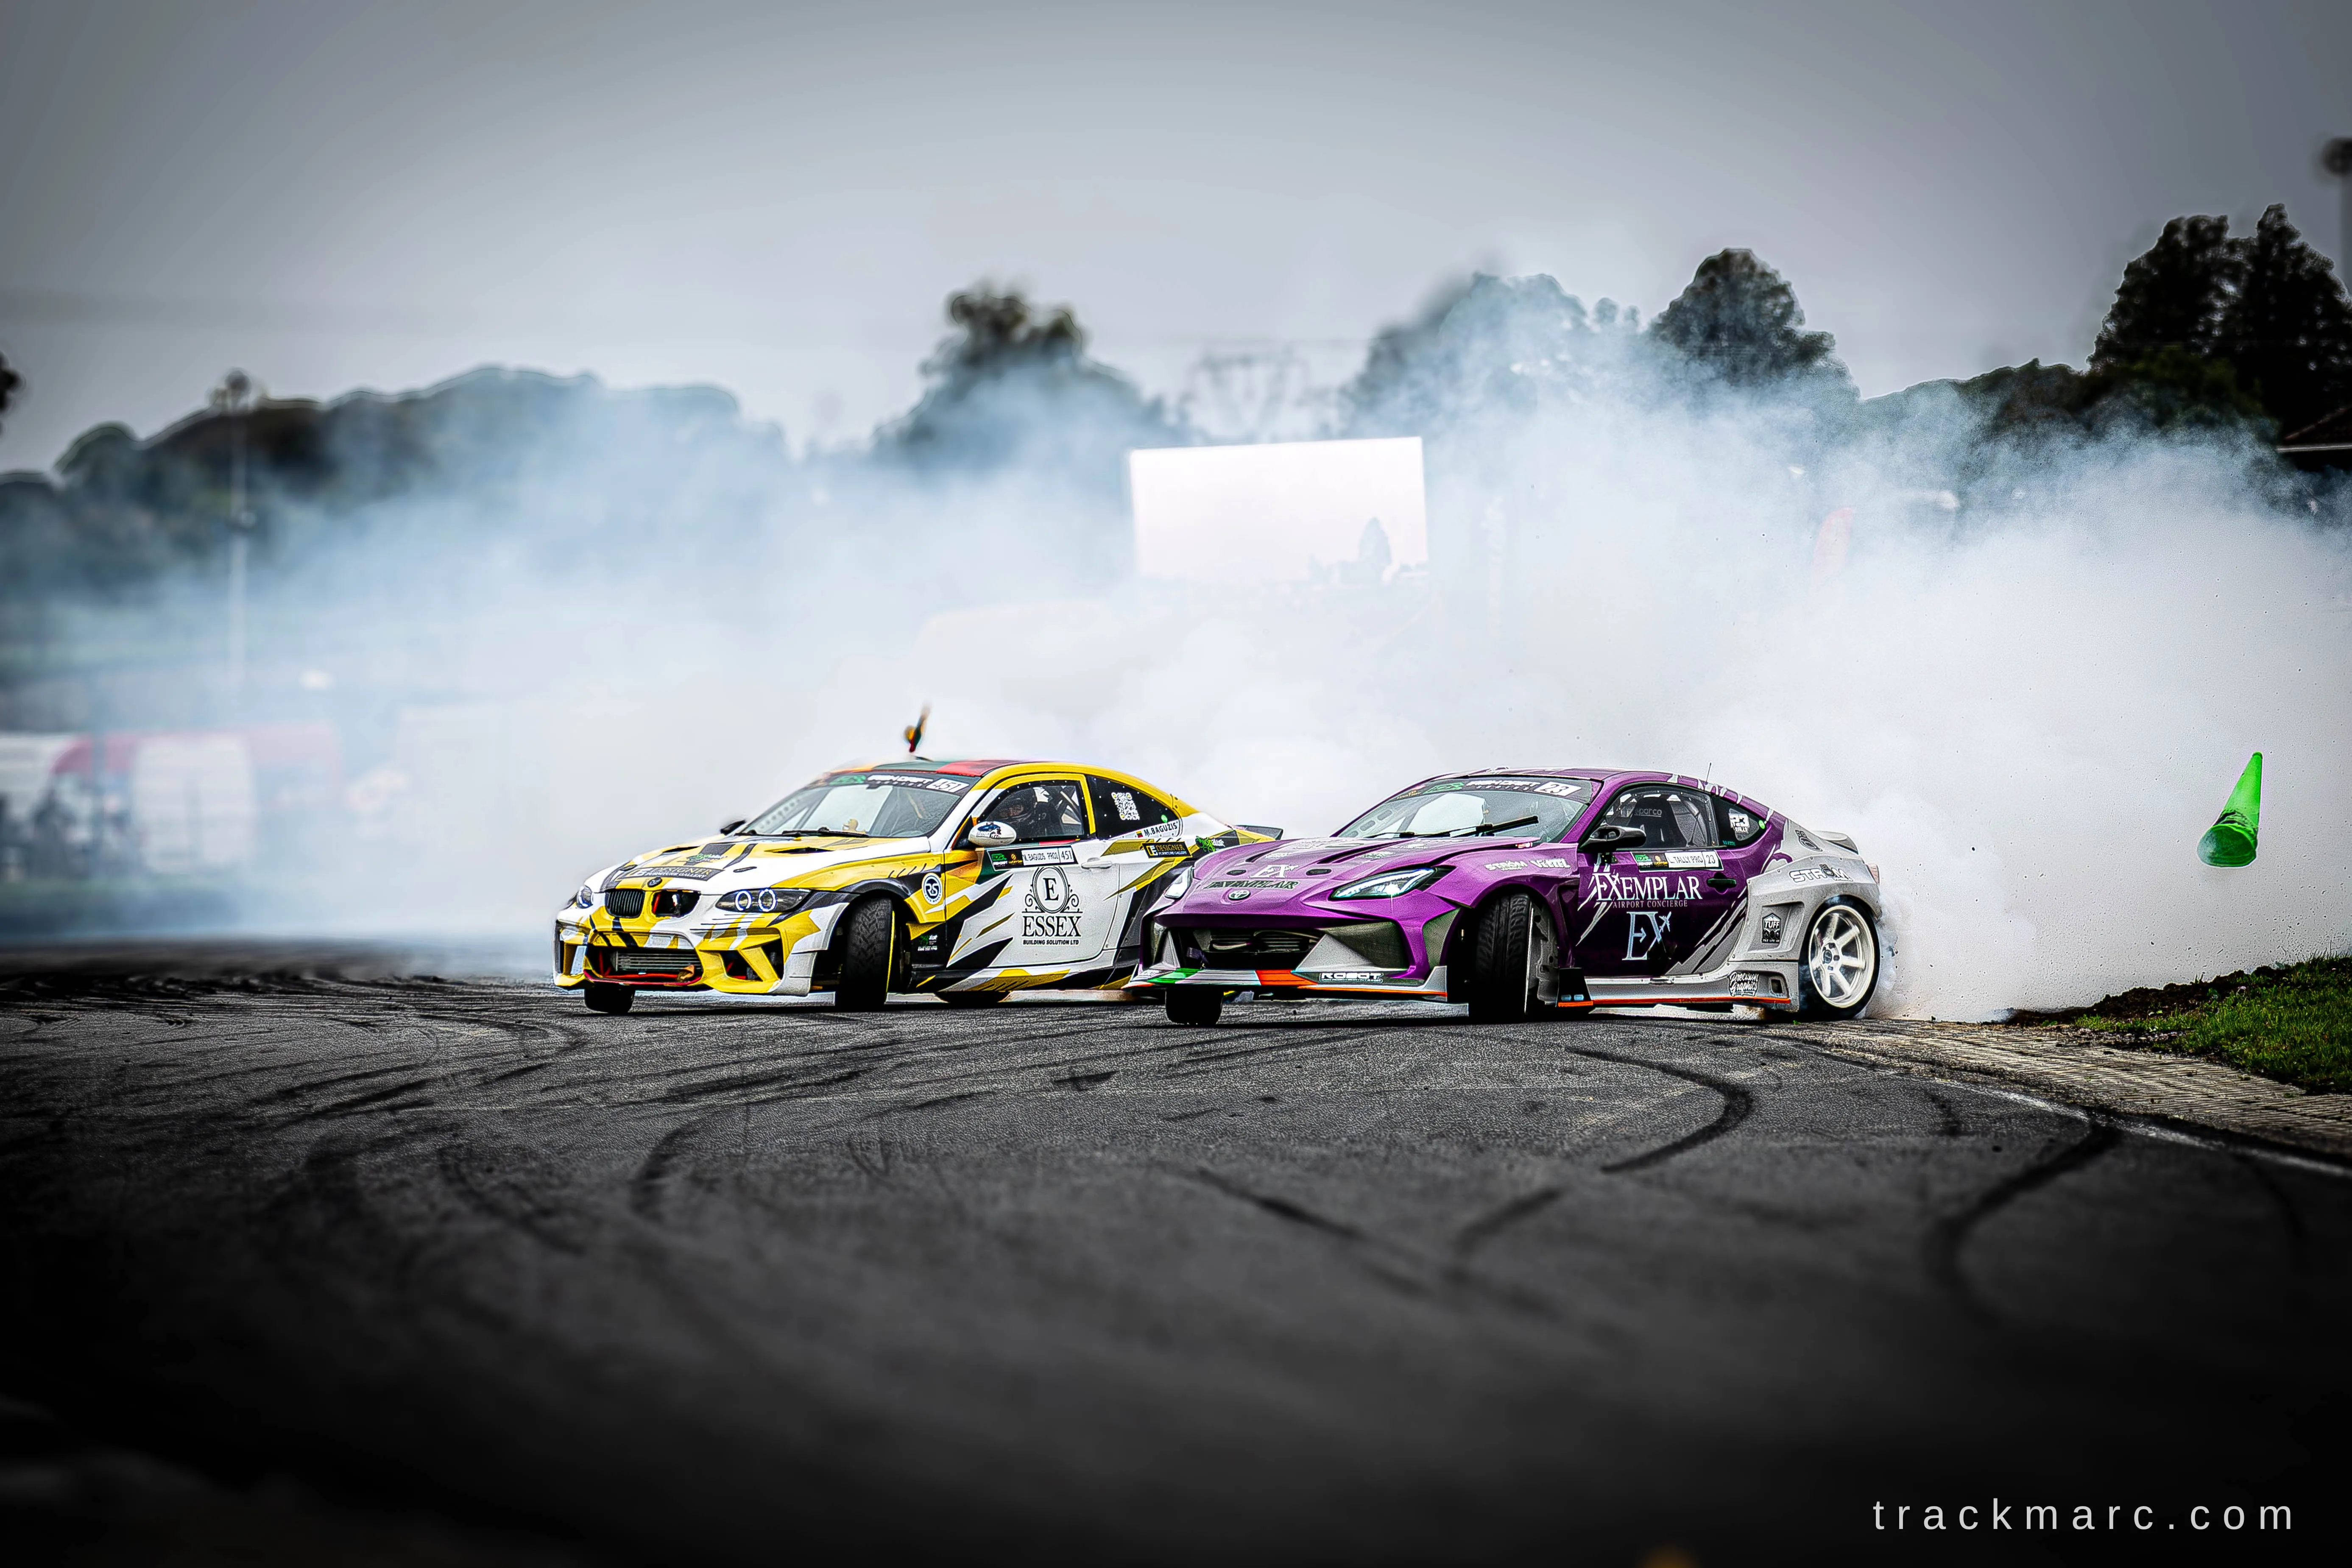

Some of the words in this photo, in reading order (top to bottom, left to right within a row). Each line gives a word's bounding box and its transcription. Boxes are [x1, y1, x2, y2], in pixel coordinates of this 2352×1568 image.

[1061, 851, 1072, 860] 451
[1706, 855, 1716, 864] 23
[1043, 878, 1059, 901] E
[1592, 873, 1702, 901] EXEMPLAR
[1613, 900, 1644, 908] AIRPORT
[1021, 916, 1082, 937] ESSEX
[1730, 972, 1759, 986] Precision
[1730, 981, 1757, 996] Graphics
